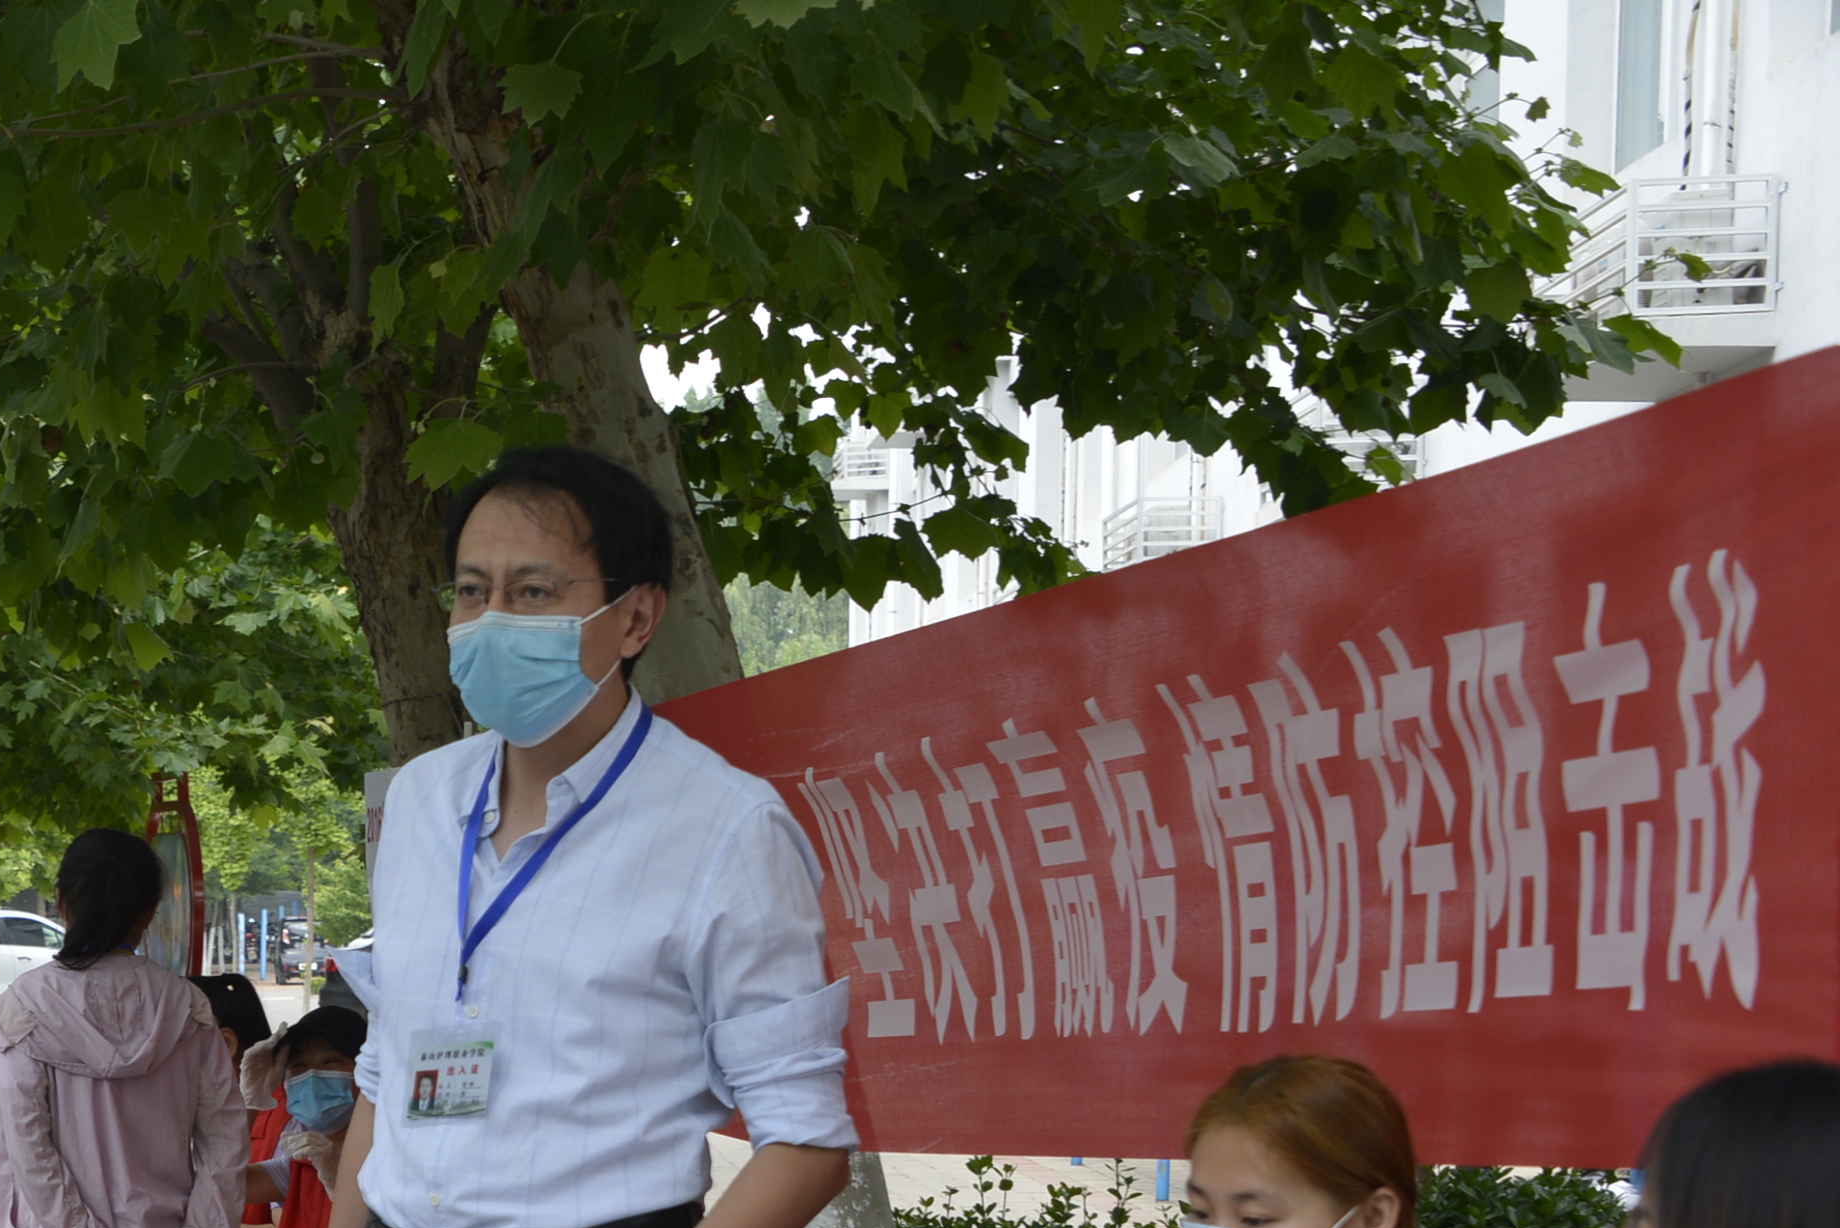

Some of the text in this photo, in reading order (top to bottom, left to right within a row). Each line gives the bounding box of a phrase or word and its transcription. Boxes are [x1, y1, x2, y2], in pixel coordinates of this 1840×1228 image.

[797, 548, 1766, 1046] 坚决打赢疫情防控阻击战
[420, 1047, 485, 1062] 泰山护理职业学院
[446, 1063, 479, 1076] 出入证
